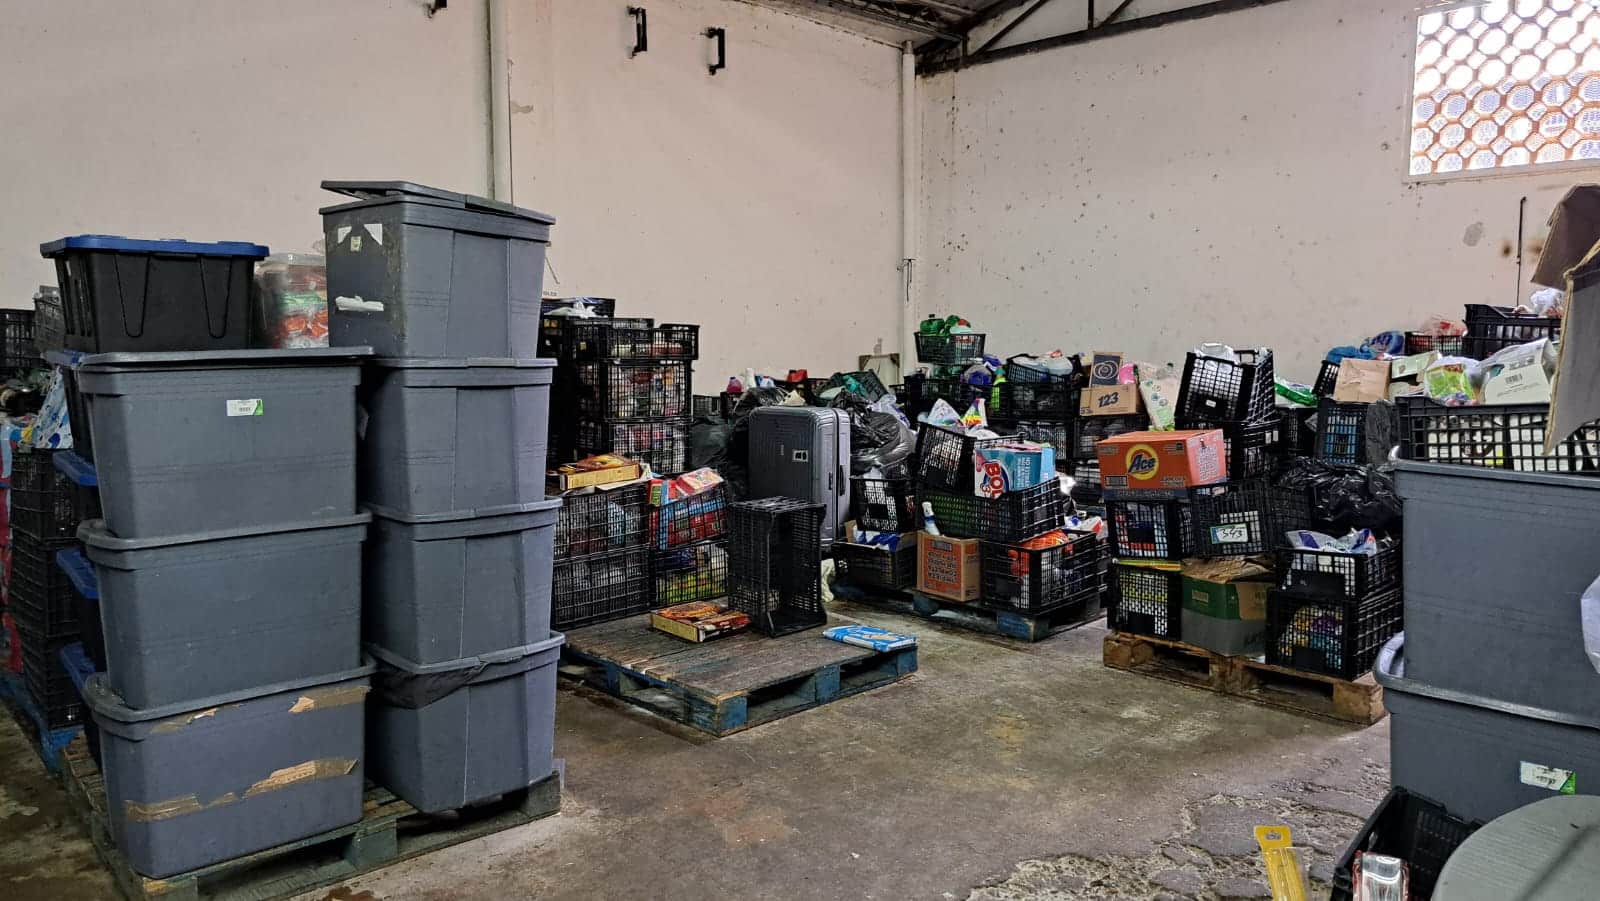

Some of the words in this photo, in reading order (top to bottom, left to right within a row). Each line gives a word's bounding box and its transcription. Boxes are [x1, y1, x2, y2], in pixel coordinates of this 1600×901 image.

[1098, 391, 1119, 408] 123
[1127, 453, 1156, 474] Ace
[984, 462, 1004, 499] BOL
